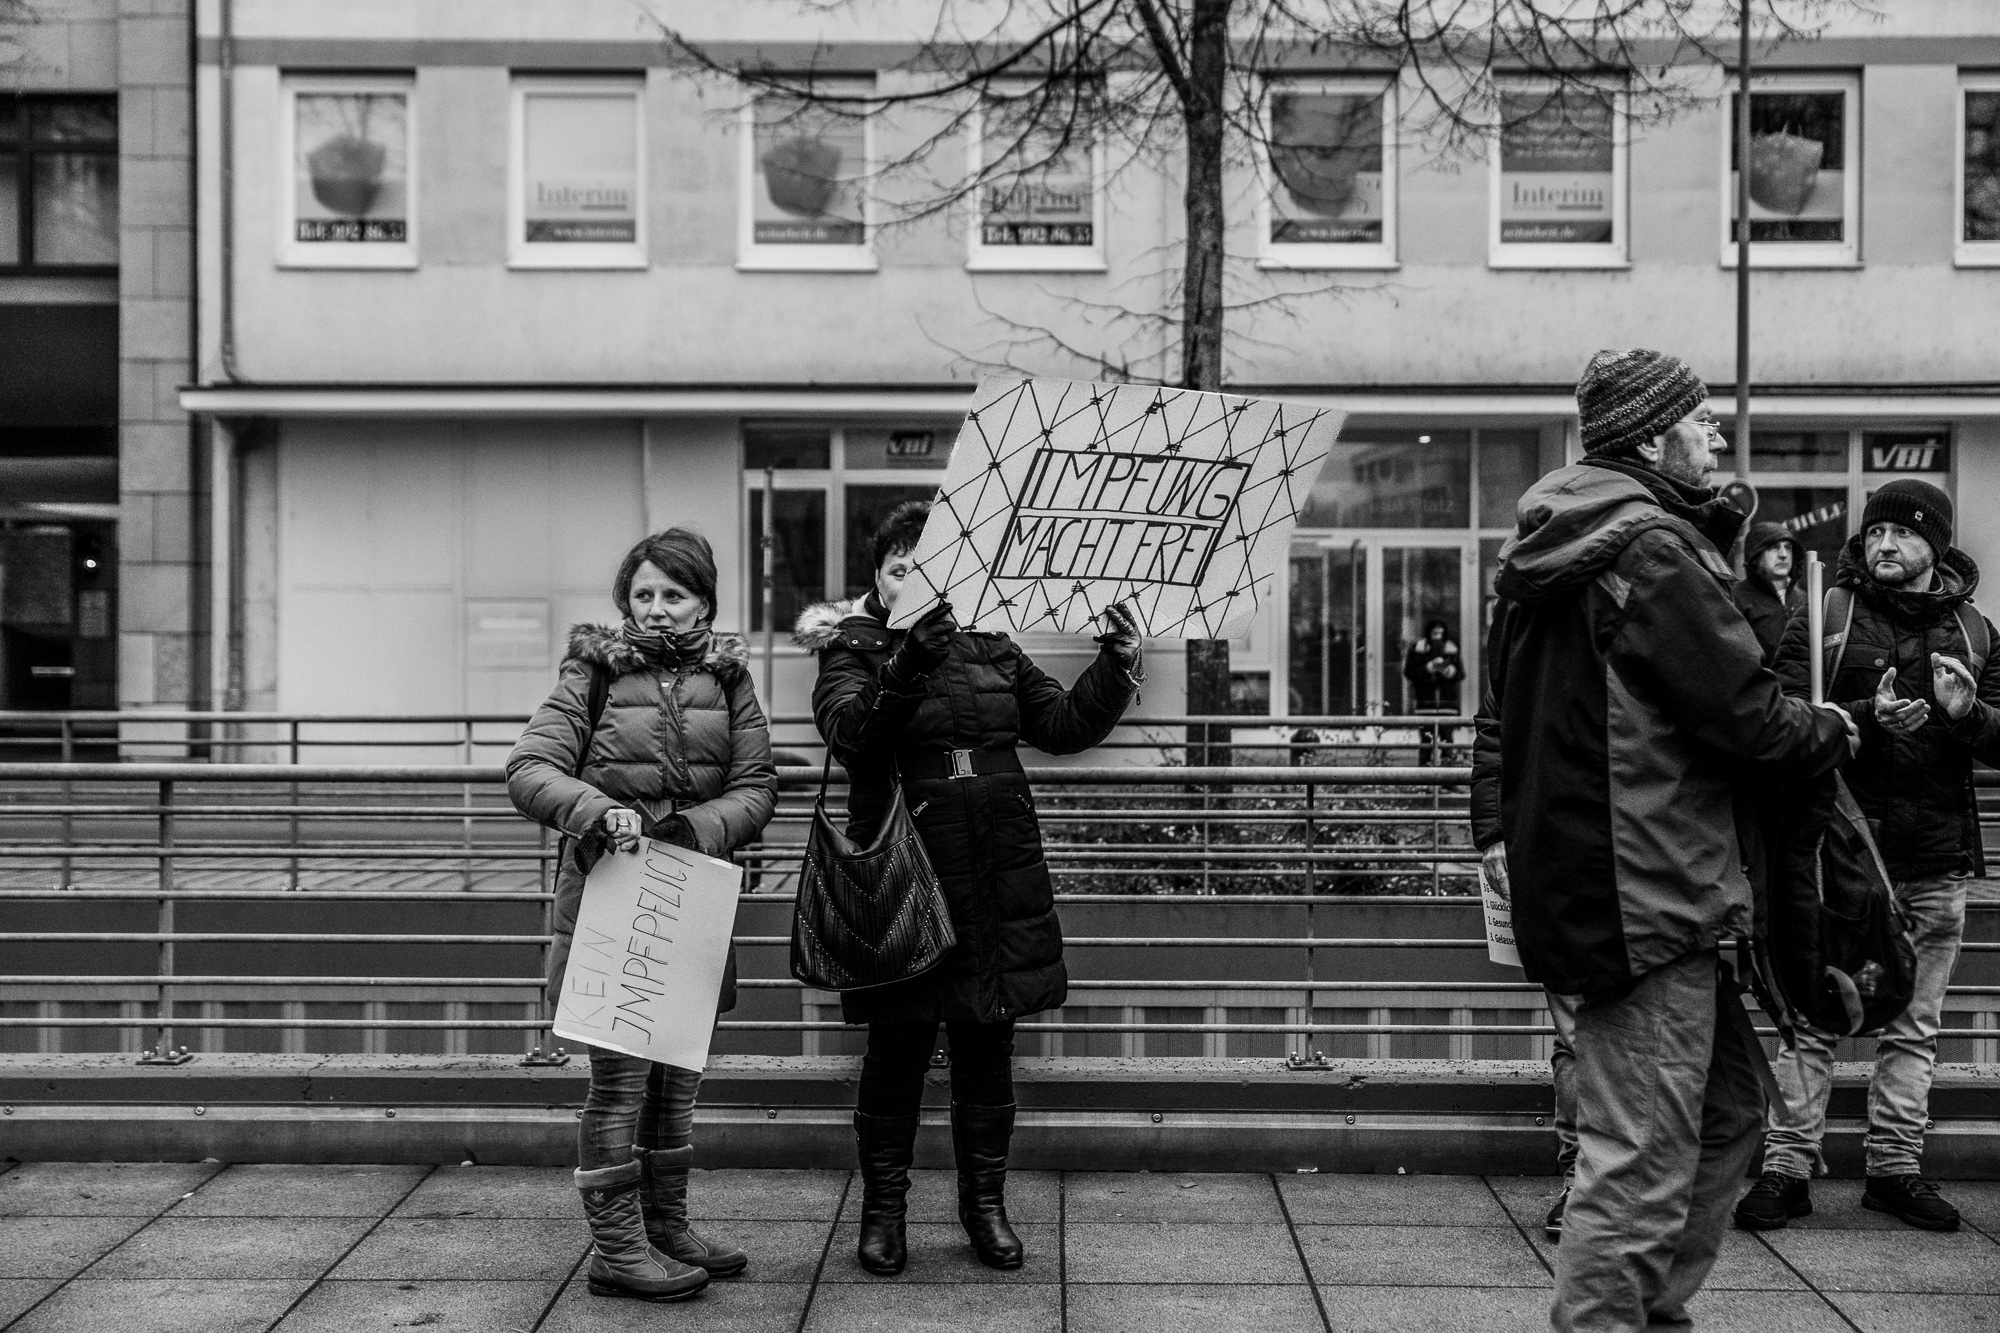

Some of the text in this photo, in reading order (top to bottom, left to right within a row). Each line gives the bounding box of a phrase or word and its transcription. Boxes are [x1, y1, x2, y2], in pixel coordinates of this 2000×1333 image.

[1513, 181, 1603, 202] Interim
[1028, 450, 1244, 519] IMPFUNG
[997, 517, 1217, 585] MACHT FREI
[560, 926, 617, 1029] KEIN
